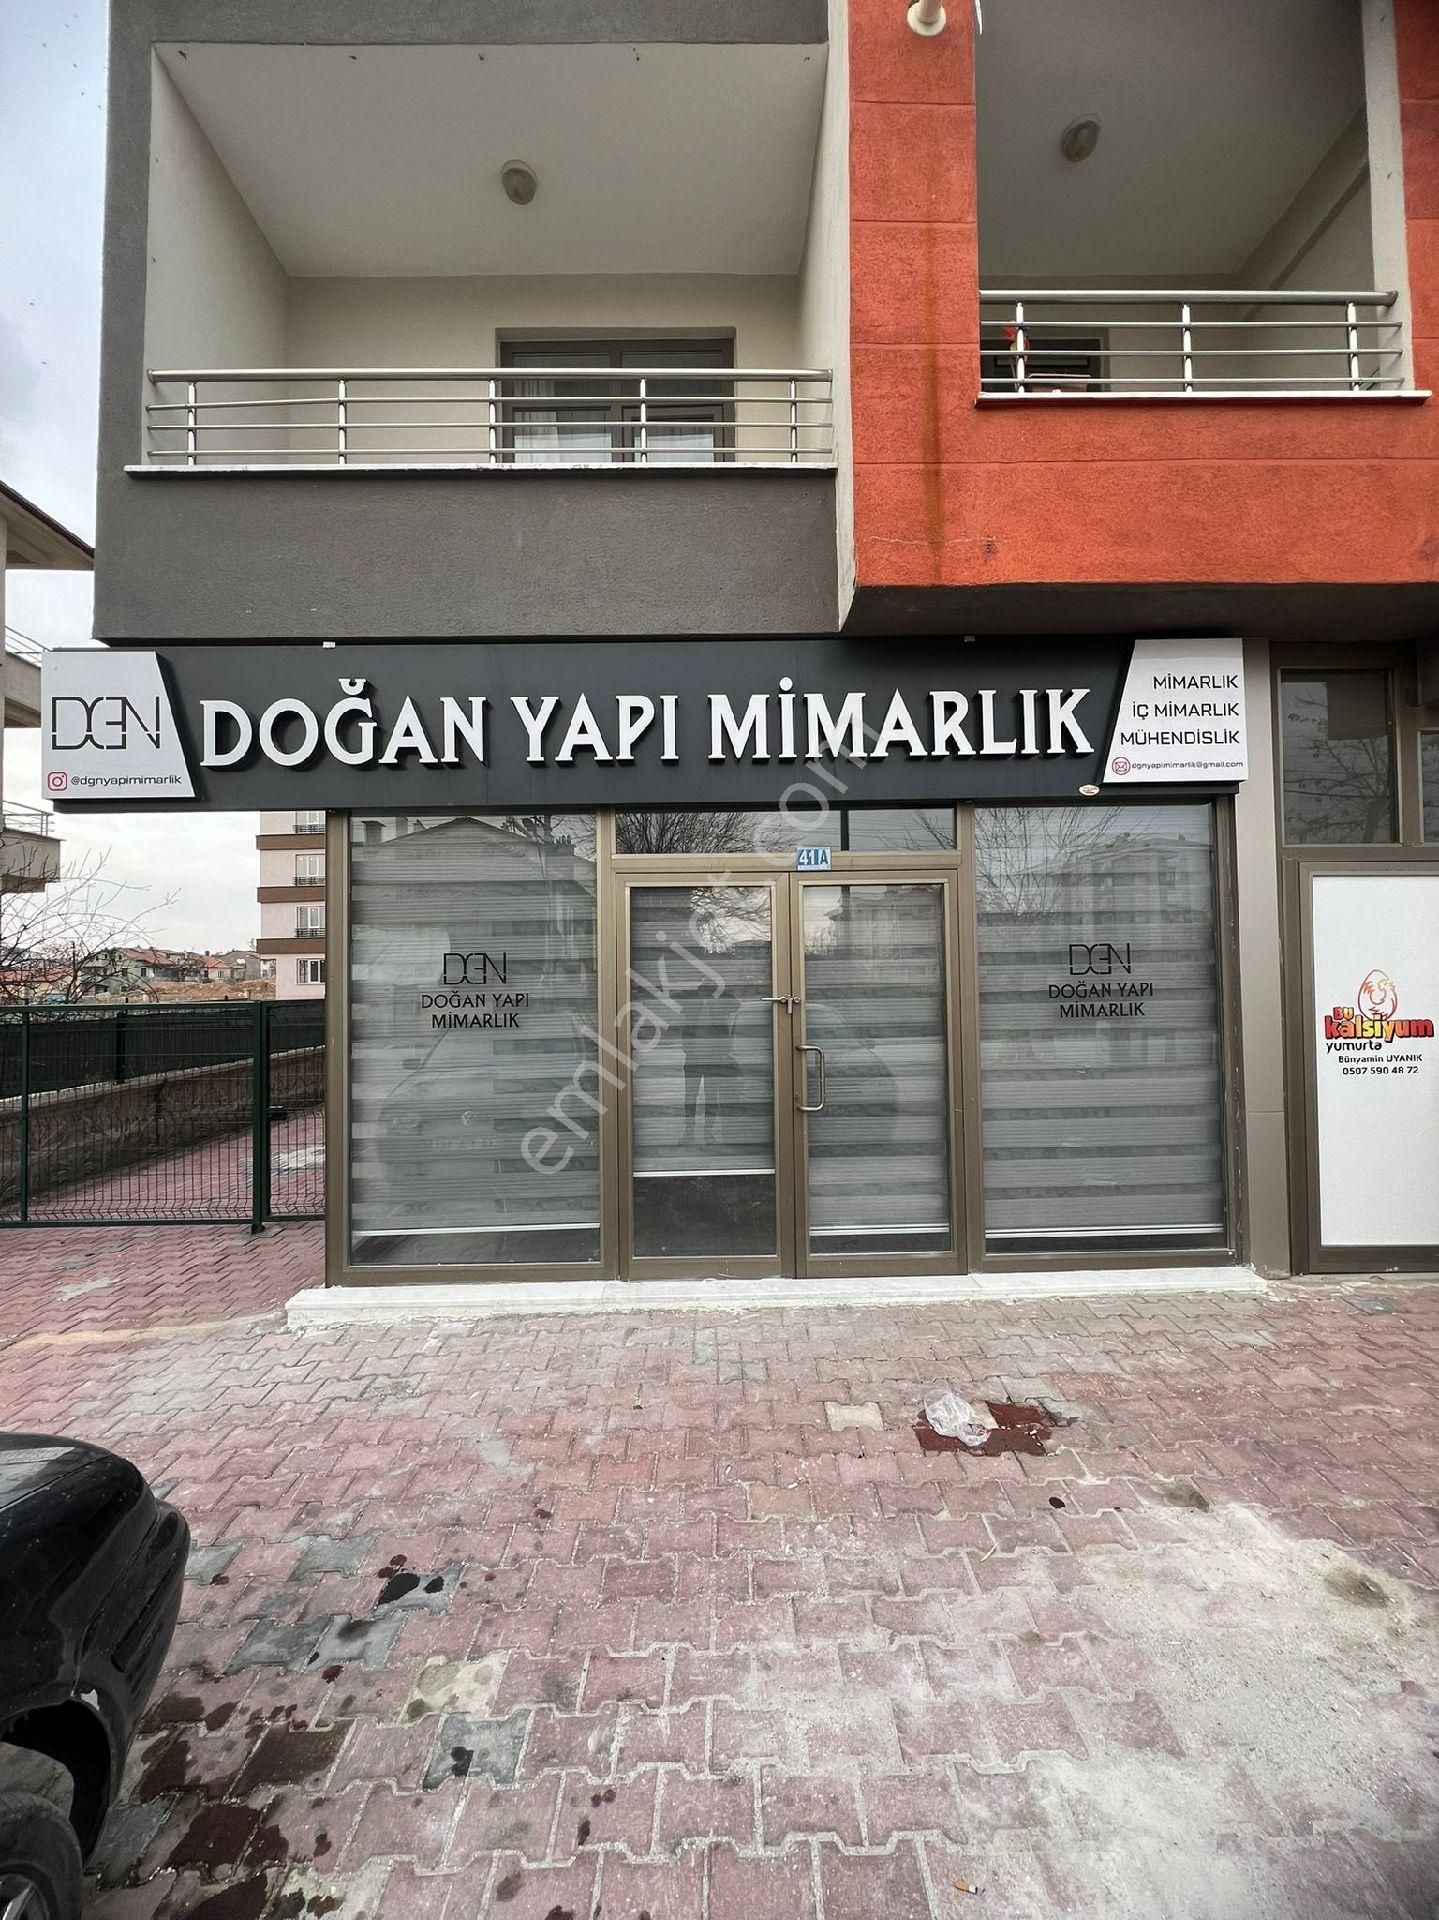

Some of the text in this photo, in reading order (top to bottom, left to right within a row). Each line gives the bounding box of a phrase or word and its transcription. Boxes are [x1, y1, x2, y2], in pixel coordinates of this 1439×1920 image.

[1153, 673, 1239, 690] MİMARLIK
[1133, 701, 1240, 720] İÇ MİMARLIK
[199, 676, 1096, 767] DOĞAN YAPI MİMARLIK
[1120, 728, 1240, 745] MÜHENDİSLİK
[71, 774, 182, 787] @dgnyapimimarlik
[1049, 980, 1153, 999] DOĞAN YAPI
[421, 990, 529, 1009] DOĞAN YAPI
[1060, 1001, 1145, 1018] MİMARLIK
[432, 1011, 520, 1029] MİMARLIK
[1325, 1012, 1435, 1043] kalsiyum
[1326, 1040, 1383, 1054] yumurta
[1338, 1053, 1423, 1064] Bünyamin UYANIK
[1342, 1066, 1368, 1075] 0507
[1370, 1066, 1389, 1075] 590
[1407, 1065, 1419, 1074] 72
